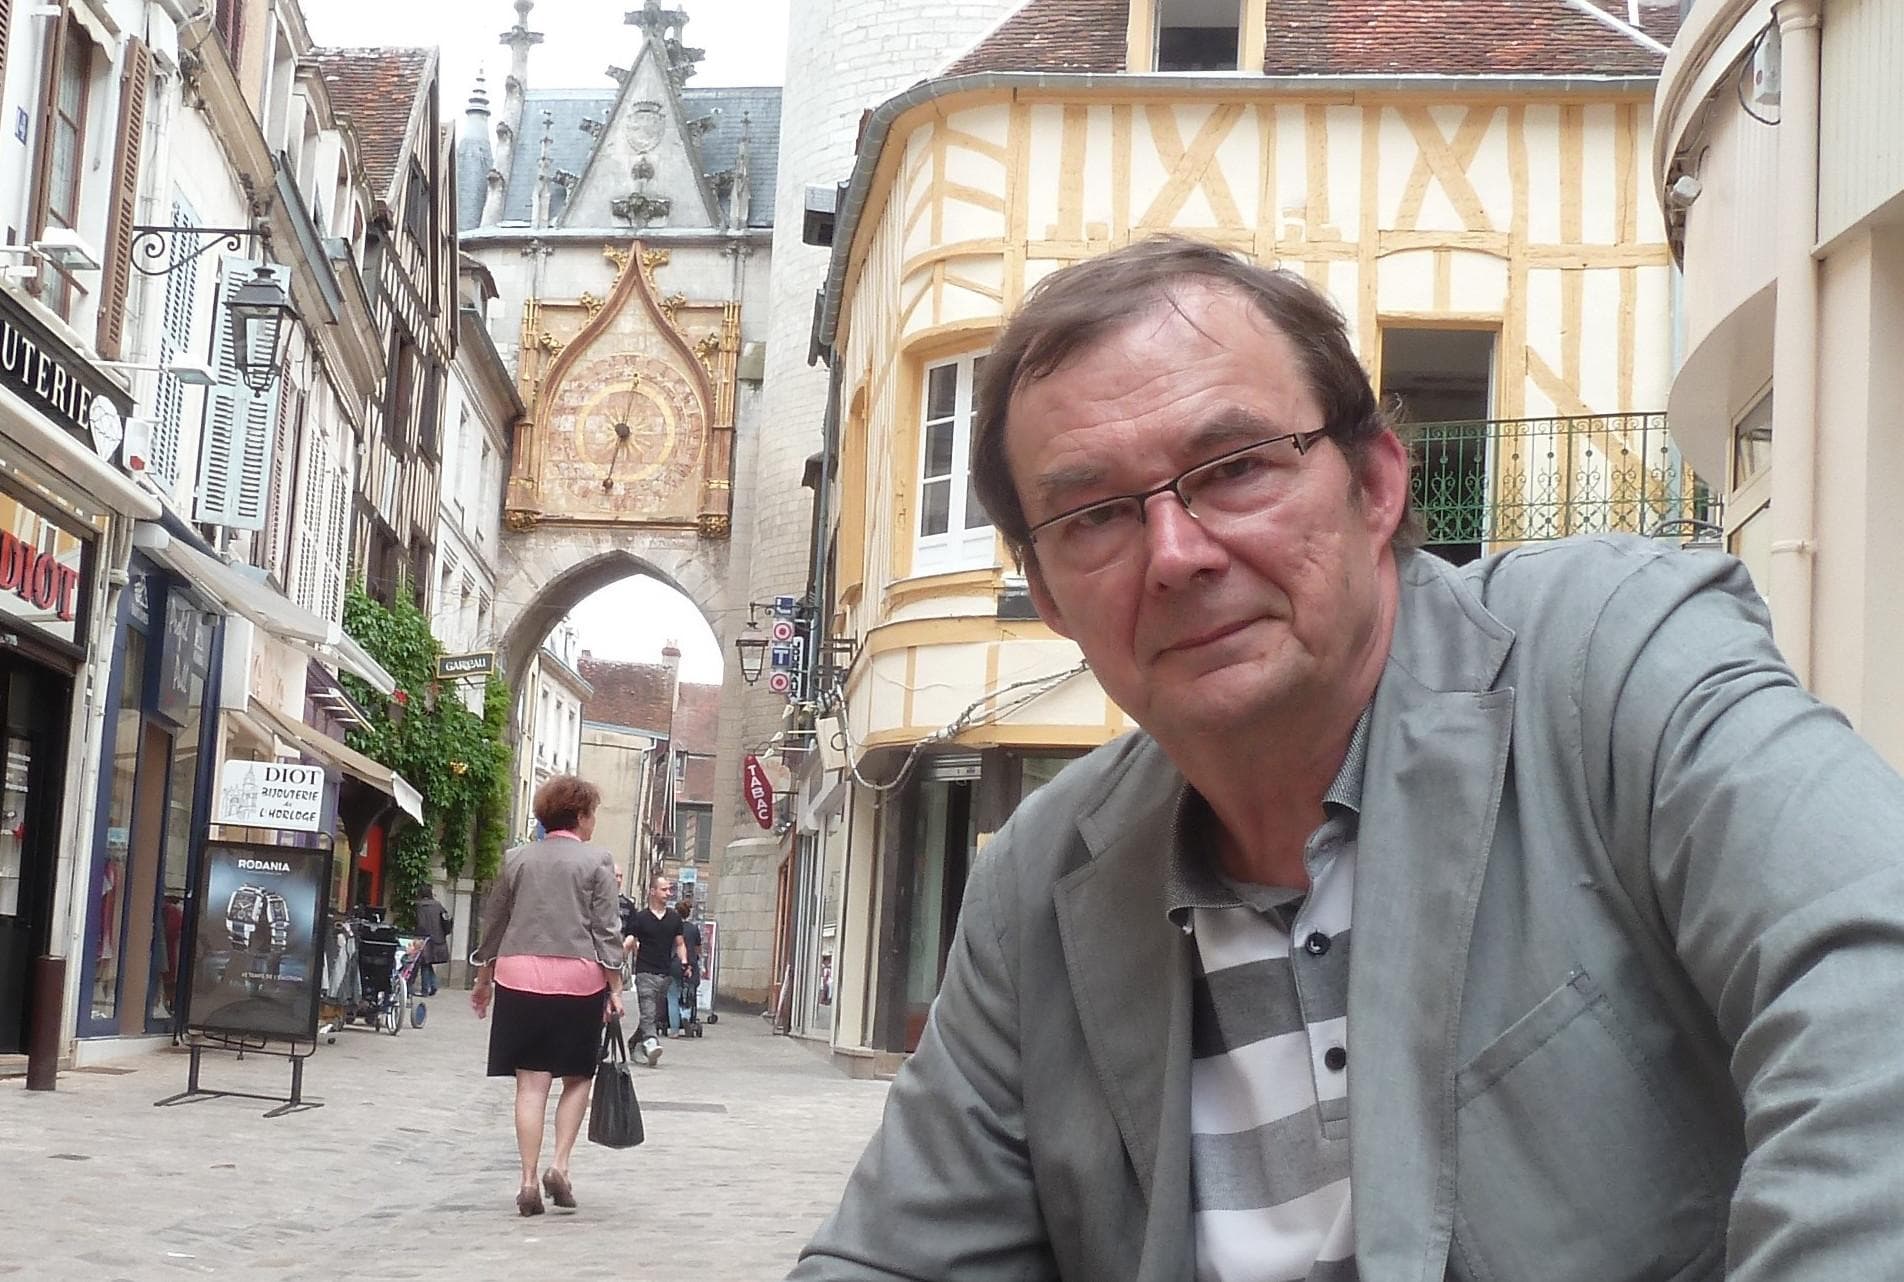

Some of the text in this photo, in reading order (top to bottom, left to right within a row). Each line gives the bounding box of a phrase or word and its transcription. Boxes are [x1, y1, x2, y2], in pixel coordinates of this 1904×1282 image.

[0, 530, 77, 621] DIOT
[265, 767, 320, 785] DIOT
[261, 787, 319, 801] BIJOUTERIE
[747, 765, 769, 820] TABAC
[238, 859, 290, 872] RODANIA
